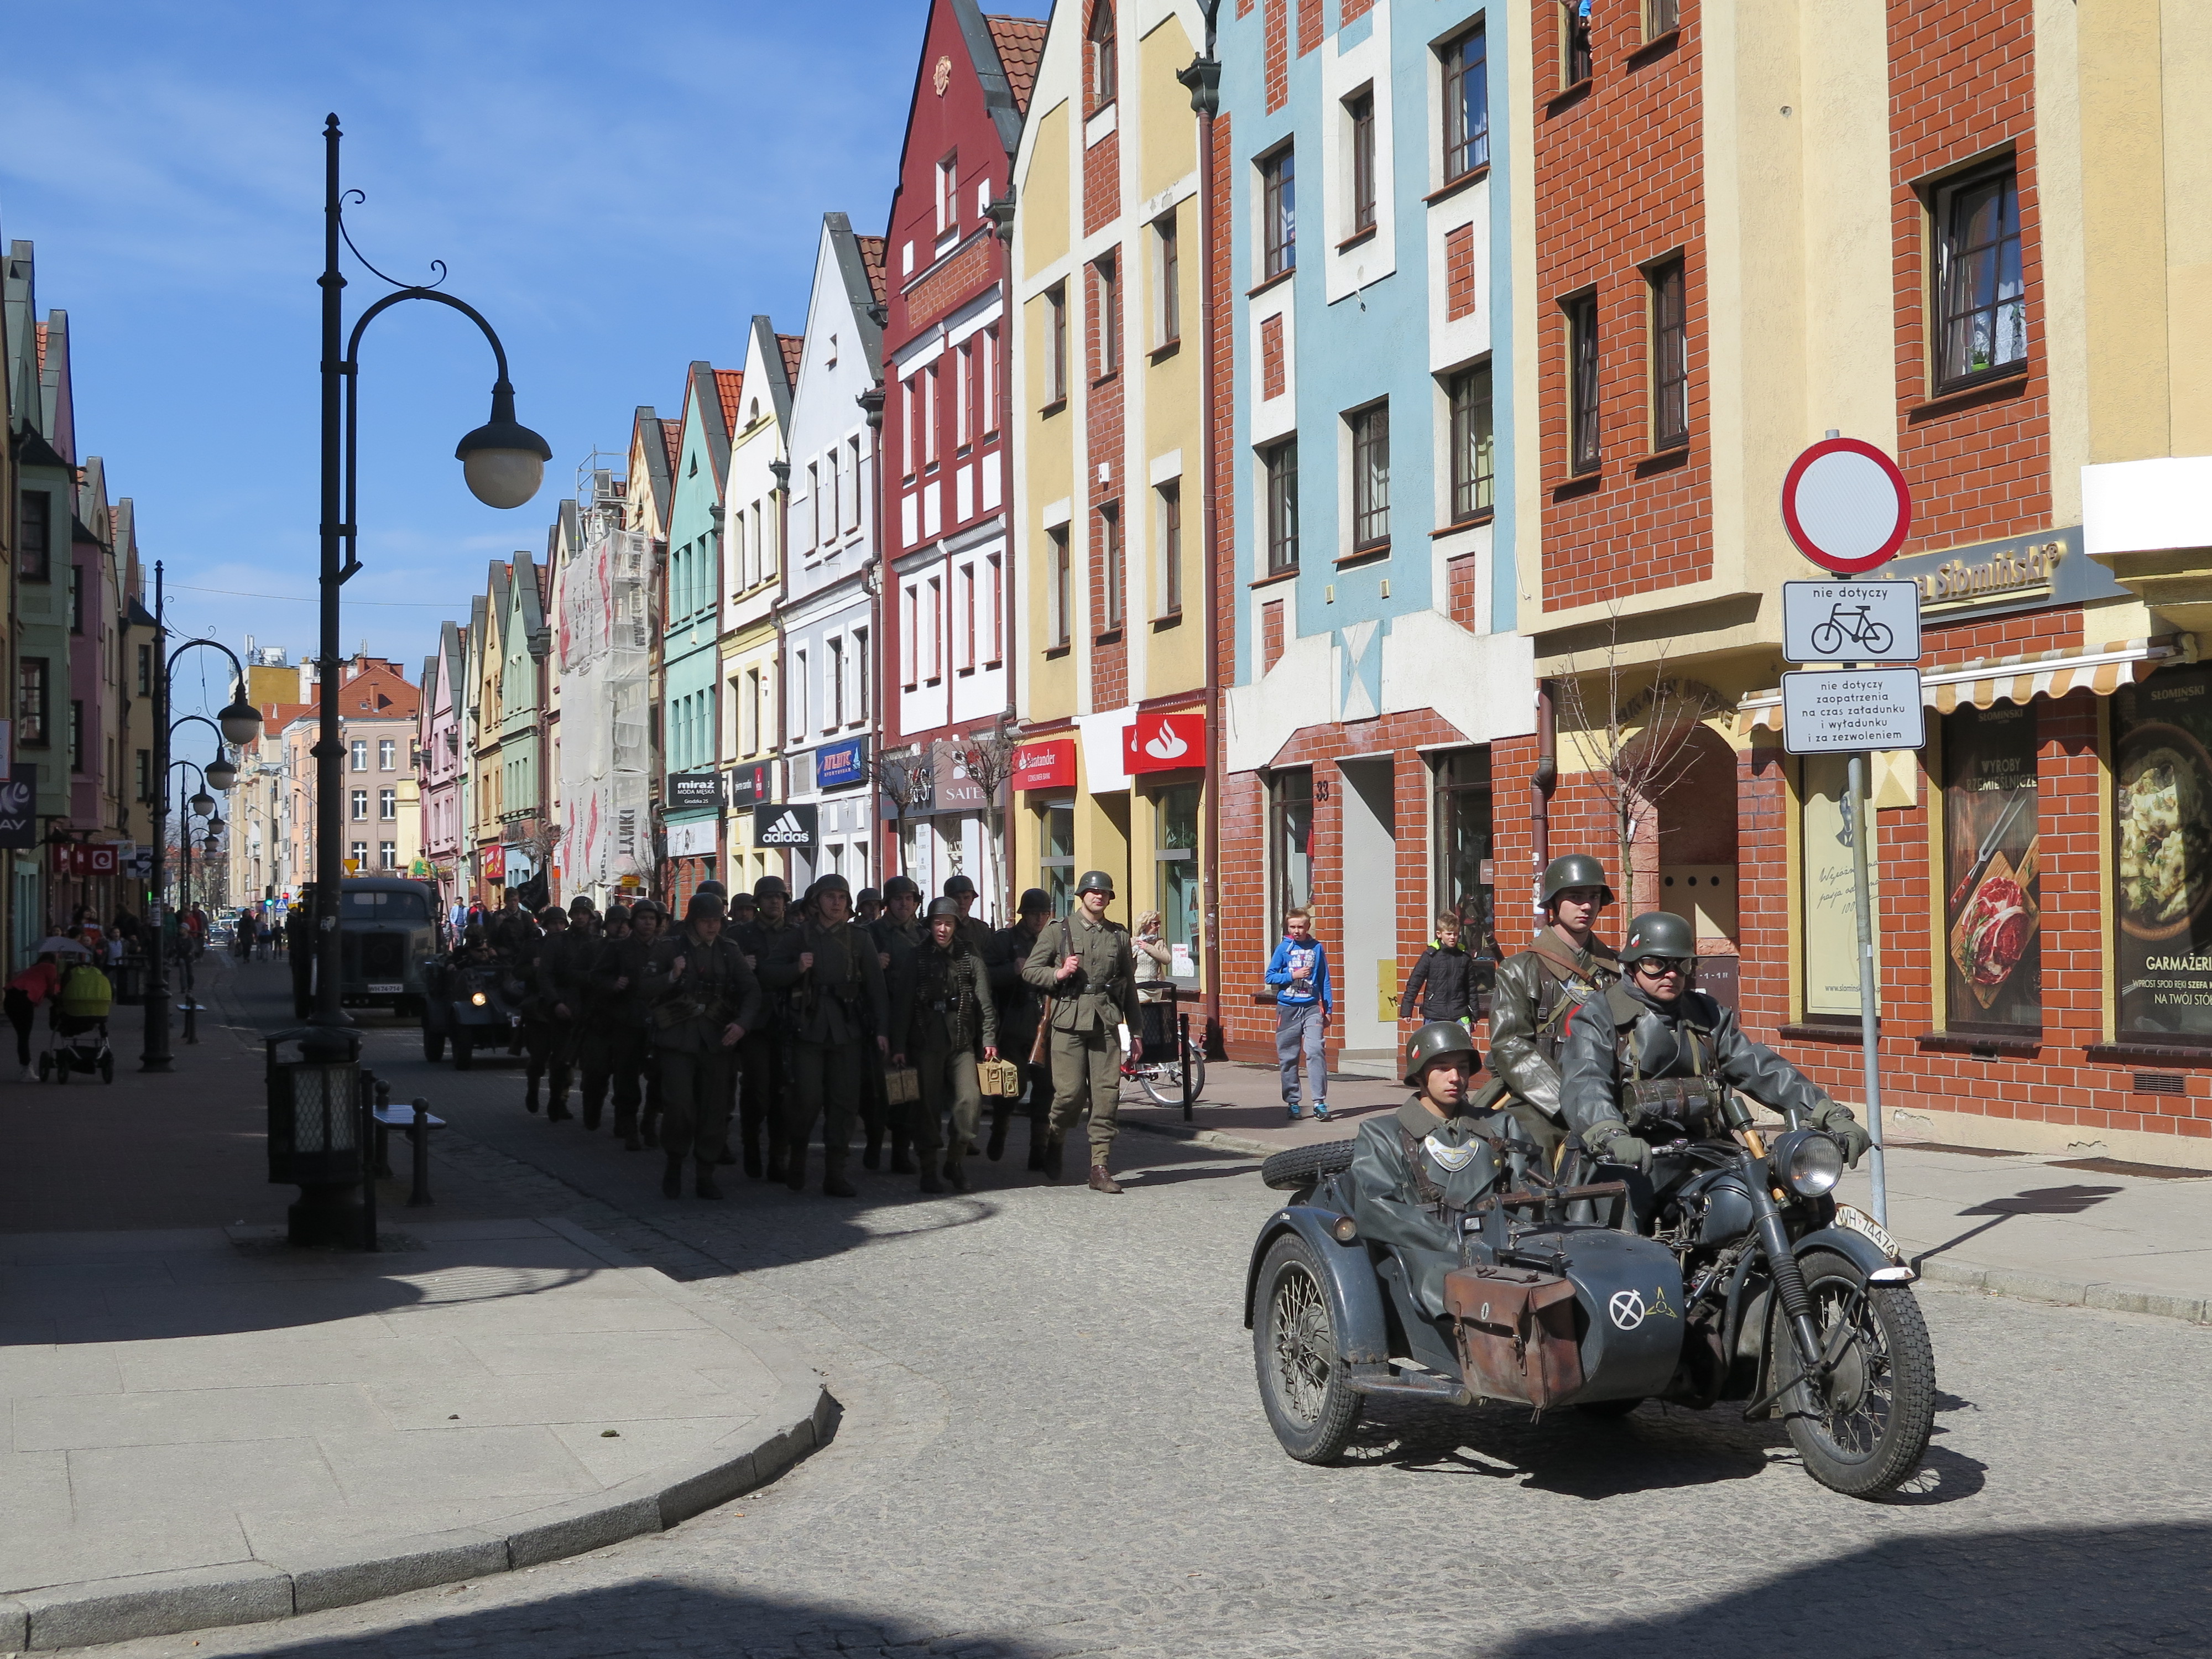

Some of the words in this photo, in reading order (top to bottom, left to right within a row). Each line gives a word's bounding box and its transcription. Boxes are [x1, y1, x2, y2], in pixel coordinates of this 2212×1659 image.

[1936, 545, 2048, 594] Słomiński
[1813, 587, 1833, 598] nie
[1839, 587, 1888, 601] dotyczy
[1821, 681, 1837, 690] nie
[1842, 680, 1884, 691] dotyczy
[1817, 693, 1888, 705] zaopatrzenia
[2151, 685, 2204, 701] SŁOMIŃSKI
[1848, 704, 1905, 714] załadunku
[1821, 720, 1824, 728] i
[1828, 719, 1888, 731] wyładunku
[1808, 734, 1811, 742] i
[1833, 731, 1902, 741] zezwoleniem
[1027, 748, 1056, 768] Santander
[1981, 758, 2021, 773] WYROBY
[677, 780, 715, 789] miraż
[1966, 773, 2038, 791] RZEMIEŚLNICZE
[1317, 780, 1329, 802] 33
[762, 831, 809, 843] adidas
[2132, 979, 2156, 988] WPROST
[2157, 980, 2173, 988] SPOD
[2174, 980, 2187, 990] RĘKI
[2188, 980, 2208, 989] SZEFA
[2154, 993, 2167, 1004] NA
[2169, 991, 2192, 1005] TWÓJ
[1838, 1208, 1856, 1227] WH
[1863, 1217, 1896, 1258] 74474
